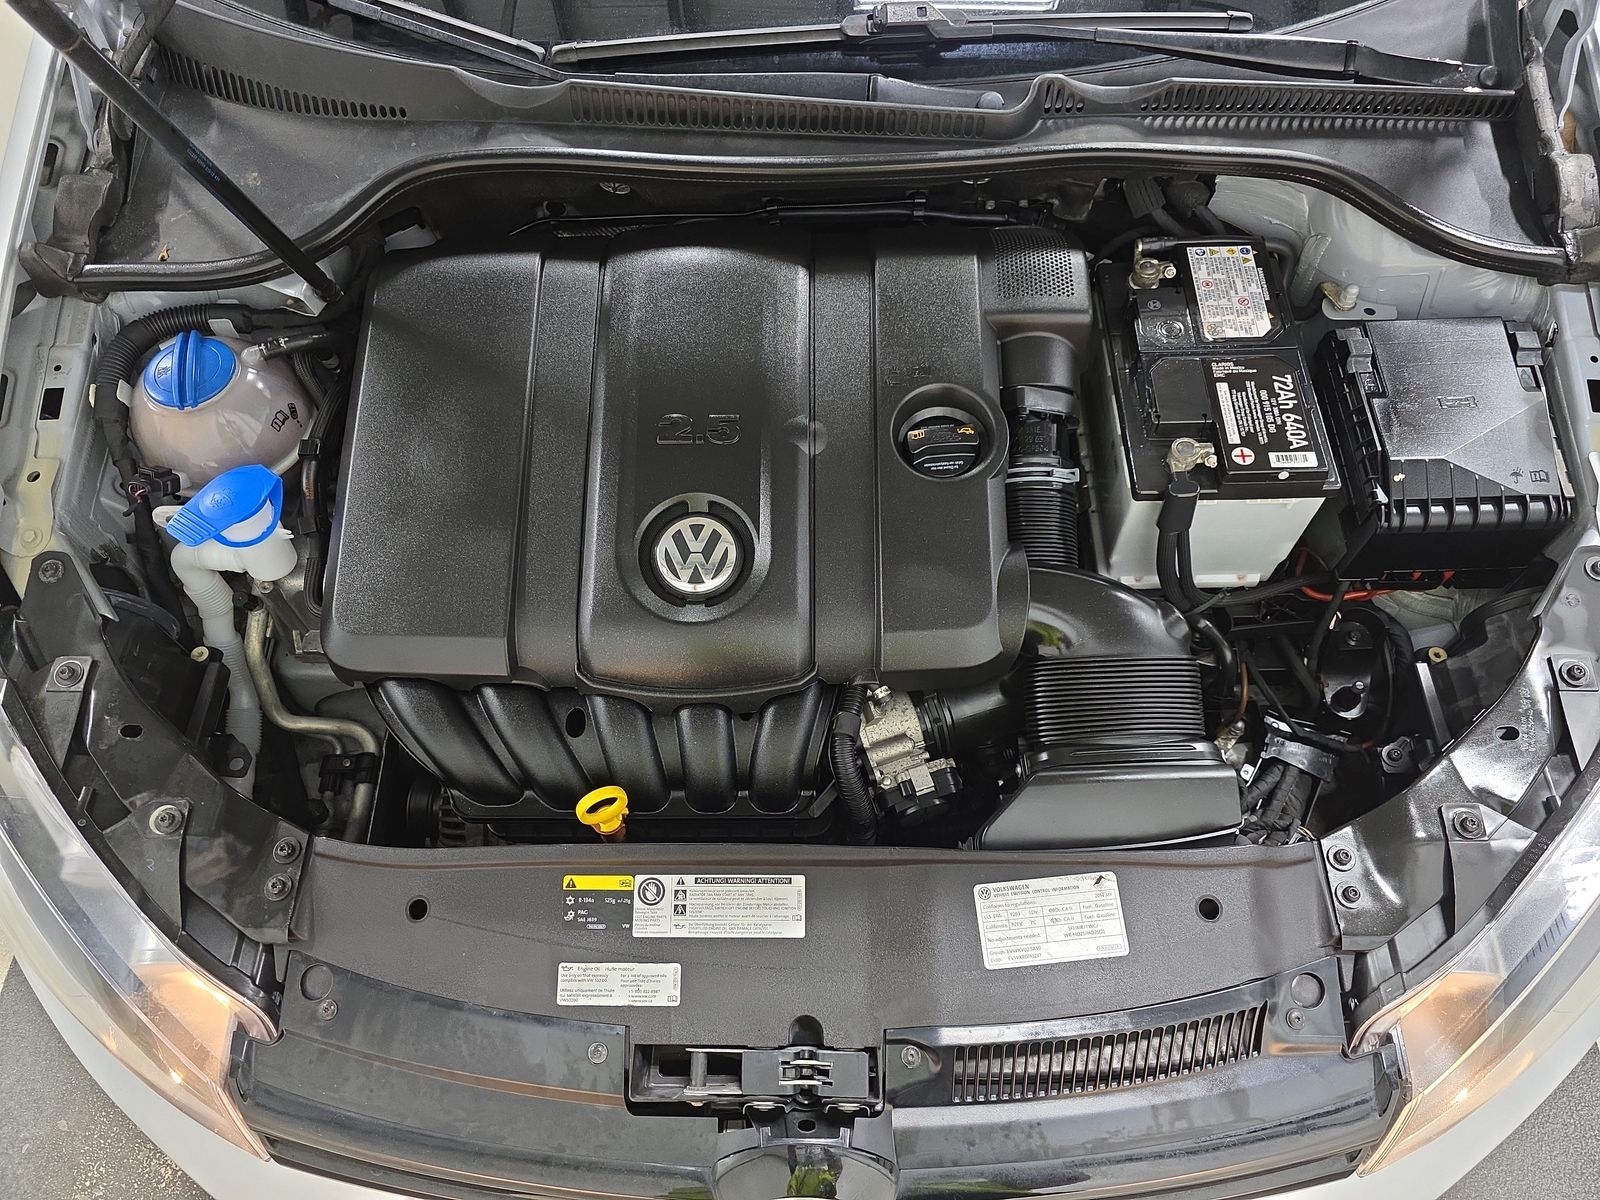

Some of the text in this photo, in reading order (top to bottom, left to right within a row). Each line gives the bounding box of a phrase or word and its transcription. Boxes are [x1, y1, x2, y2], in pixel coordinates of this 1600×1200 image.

[1260, 390, 1269, 401] 000
[1263, 401, 1271, 413] 915
[1272, 374, 1298, 409] 72Ah
[656, 413, 742, 444] 2.5
[1282, 413, 1308, 450] 640A
[656, 516, 736, 595] VW
[992, 884, 1030, 893] VOLKSWAGEN
